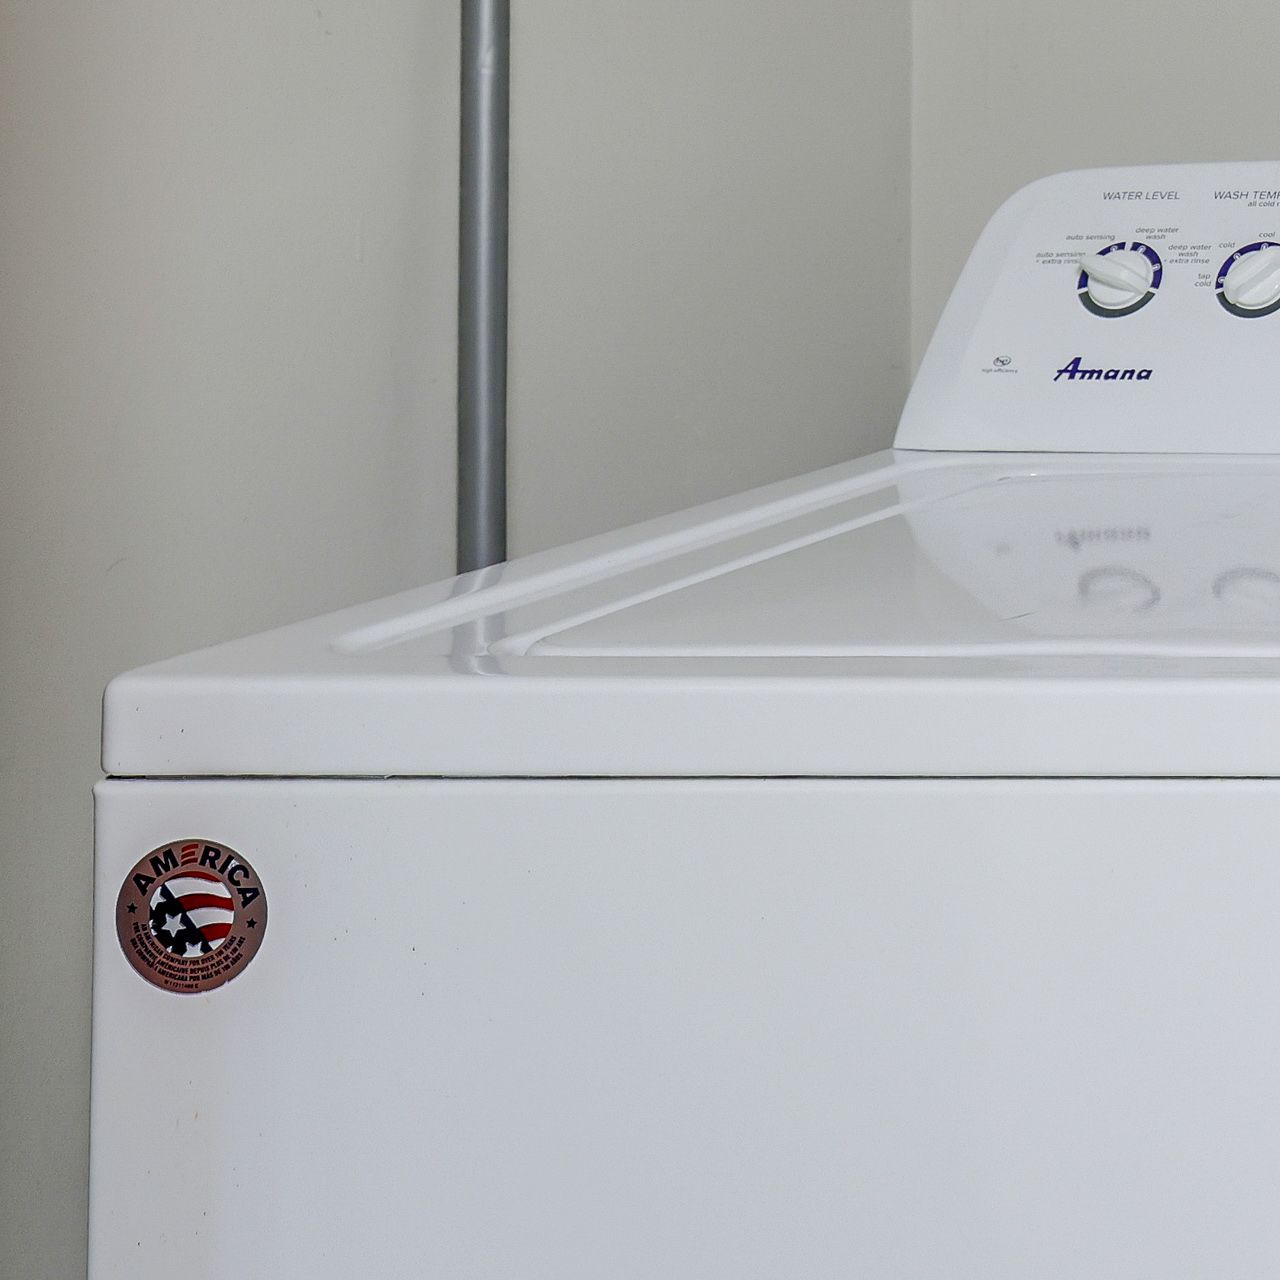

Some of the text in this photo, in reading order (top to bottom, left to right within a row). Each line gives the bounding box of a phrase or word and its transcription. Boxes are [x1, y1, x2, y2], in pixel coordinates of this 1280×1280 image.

[1102, 191, 1181, 201] WATER LEVEL
[1213, 191, 1249, 200] WASH
[1053, 356, 1153, 382] Amana
[132, 843, 260, 909] AMERICA
